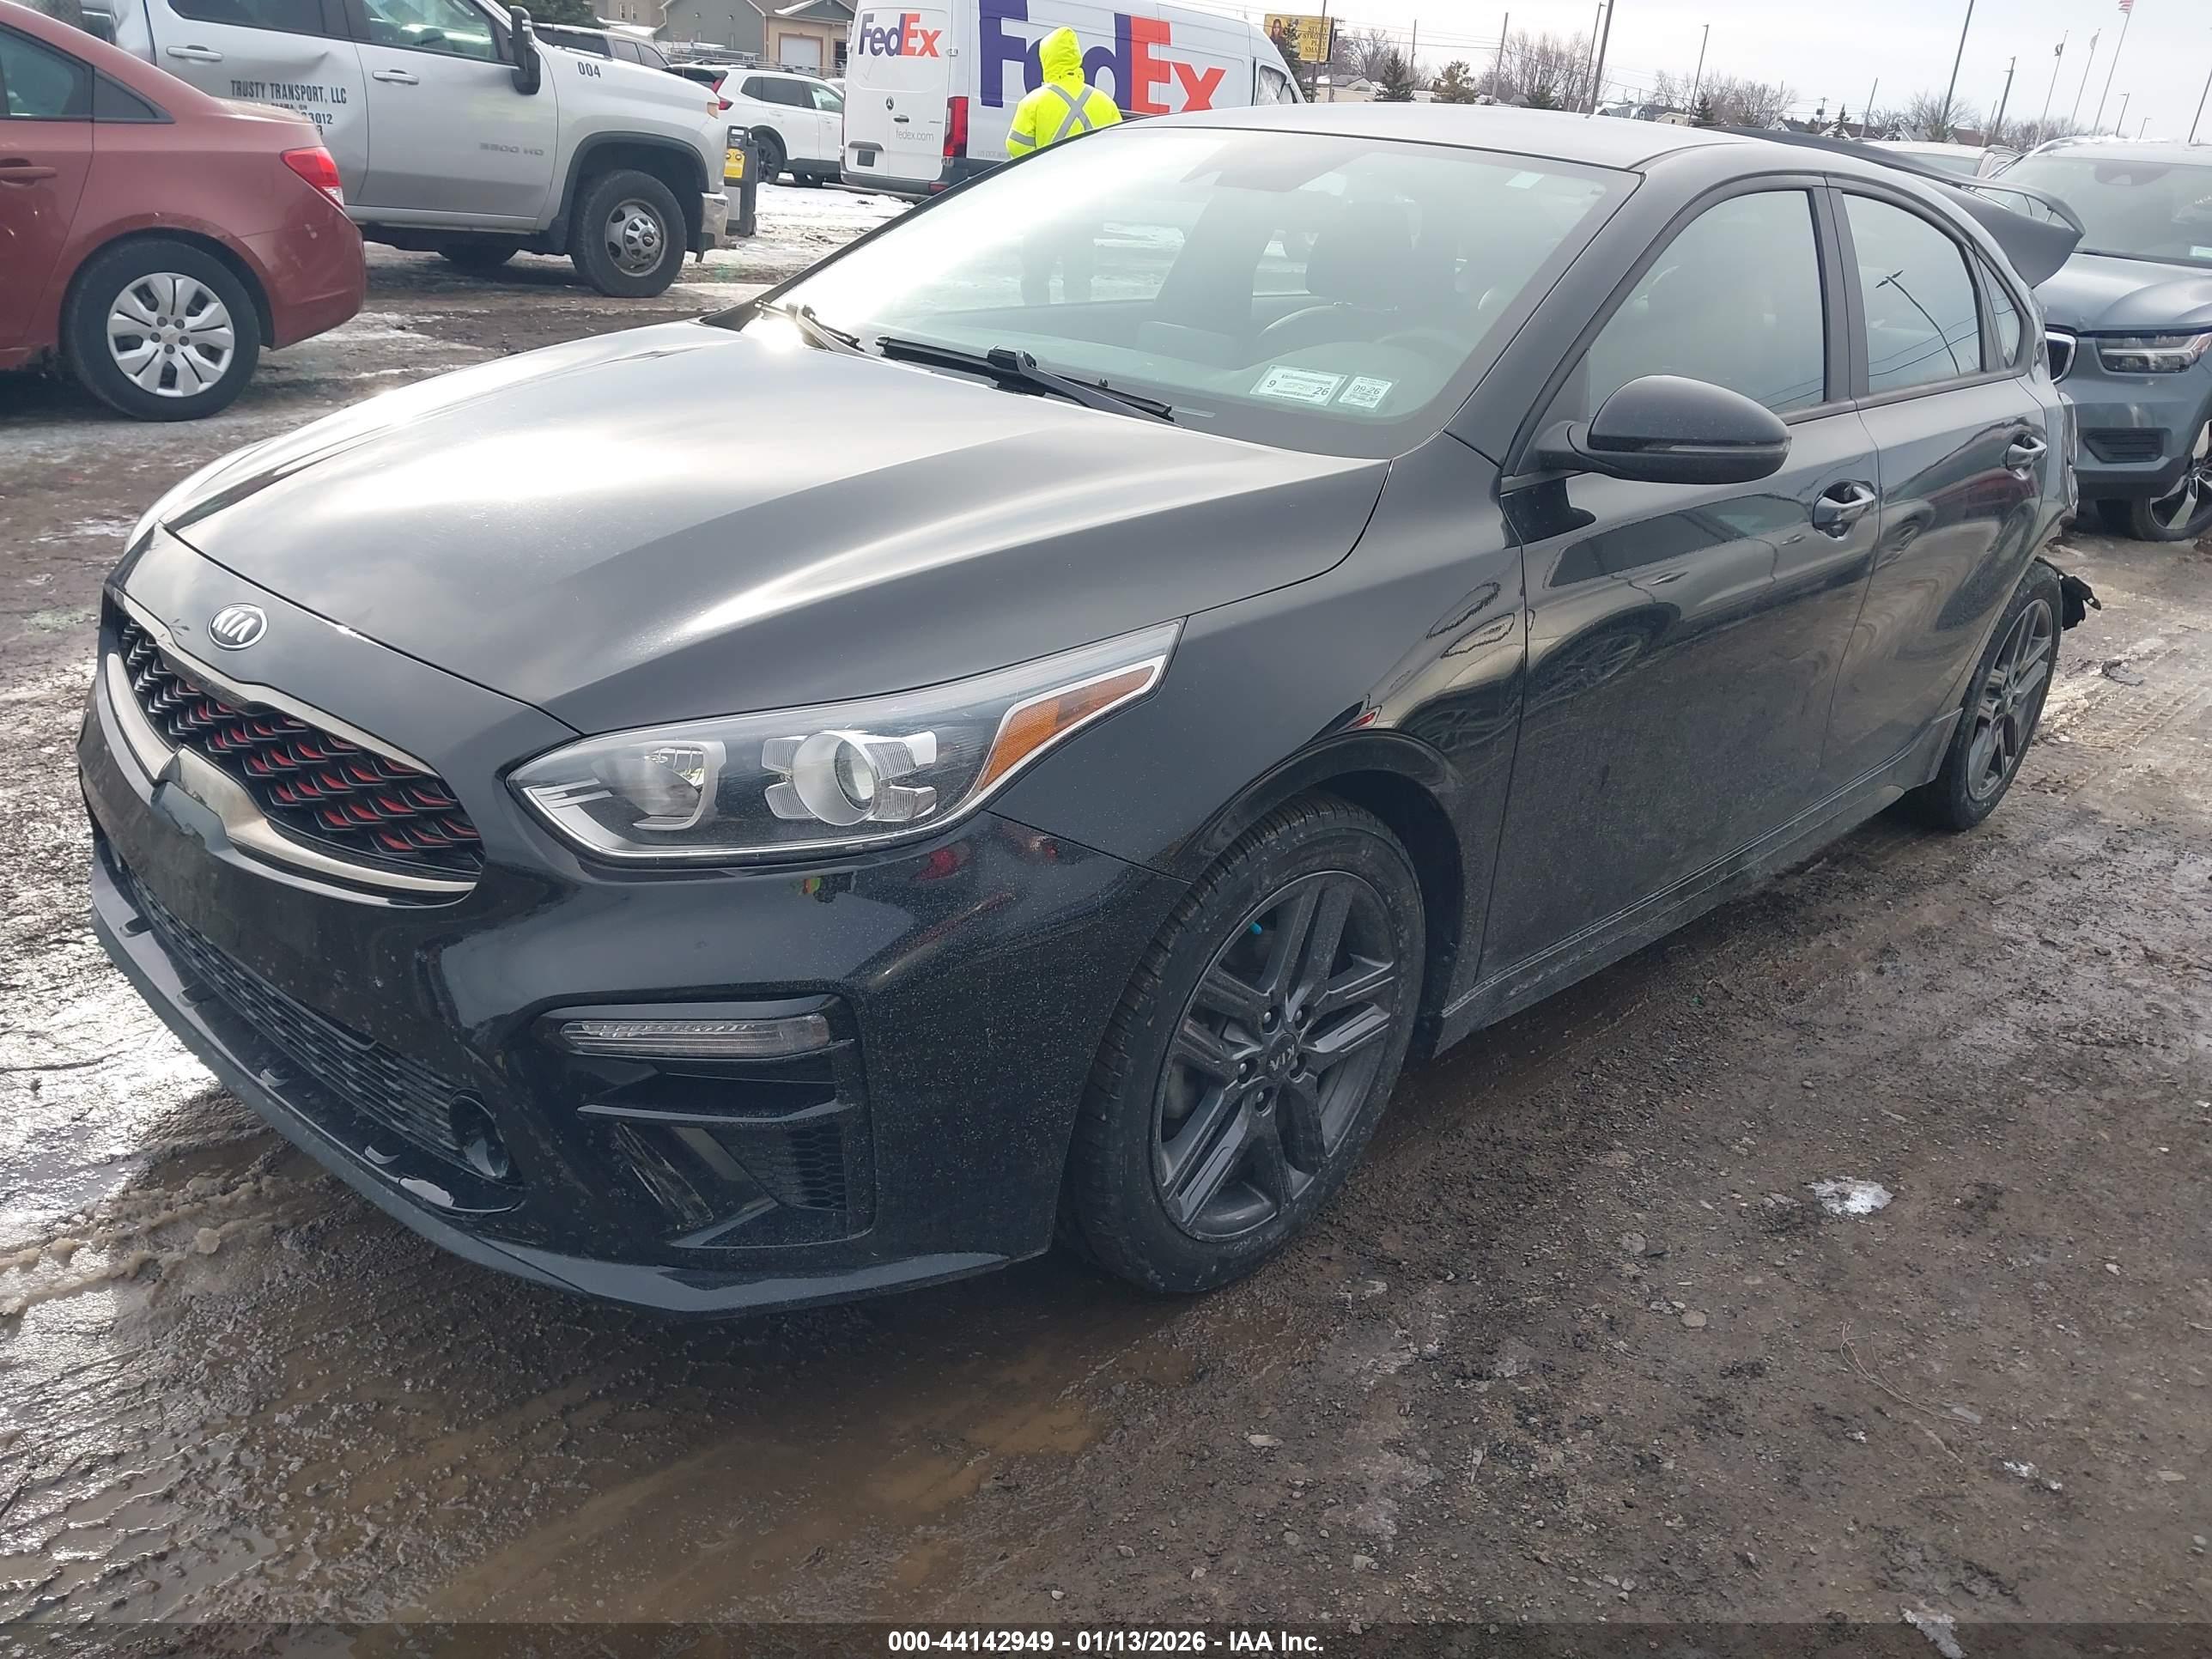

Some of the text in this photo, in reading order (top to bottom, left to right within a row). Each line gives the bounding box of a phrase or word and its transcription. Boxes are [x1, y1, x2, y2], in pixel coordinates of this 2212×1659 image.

[859, 14, 942, 58] FedEx
[578, 62, 601, 77] 004
[230, 80, 347, 104] TRUSTY TRANSPORT, LLC
[896, 130, 934, 142] fedex.com
[1267, 380, 1277, 388] 9
[1311, 386, 1329, 396] 26
[211, 609, 257, 643] KIA
